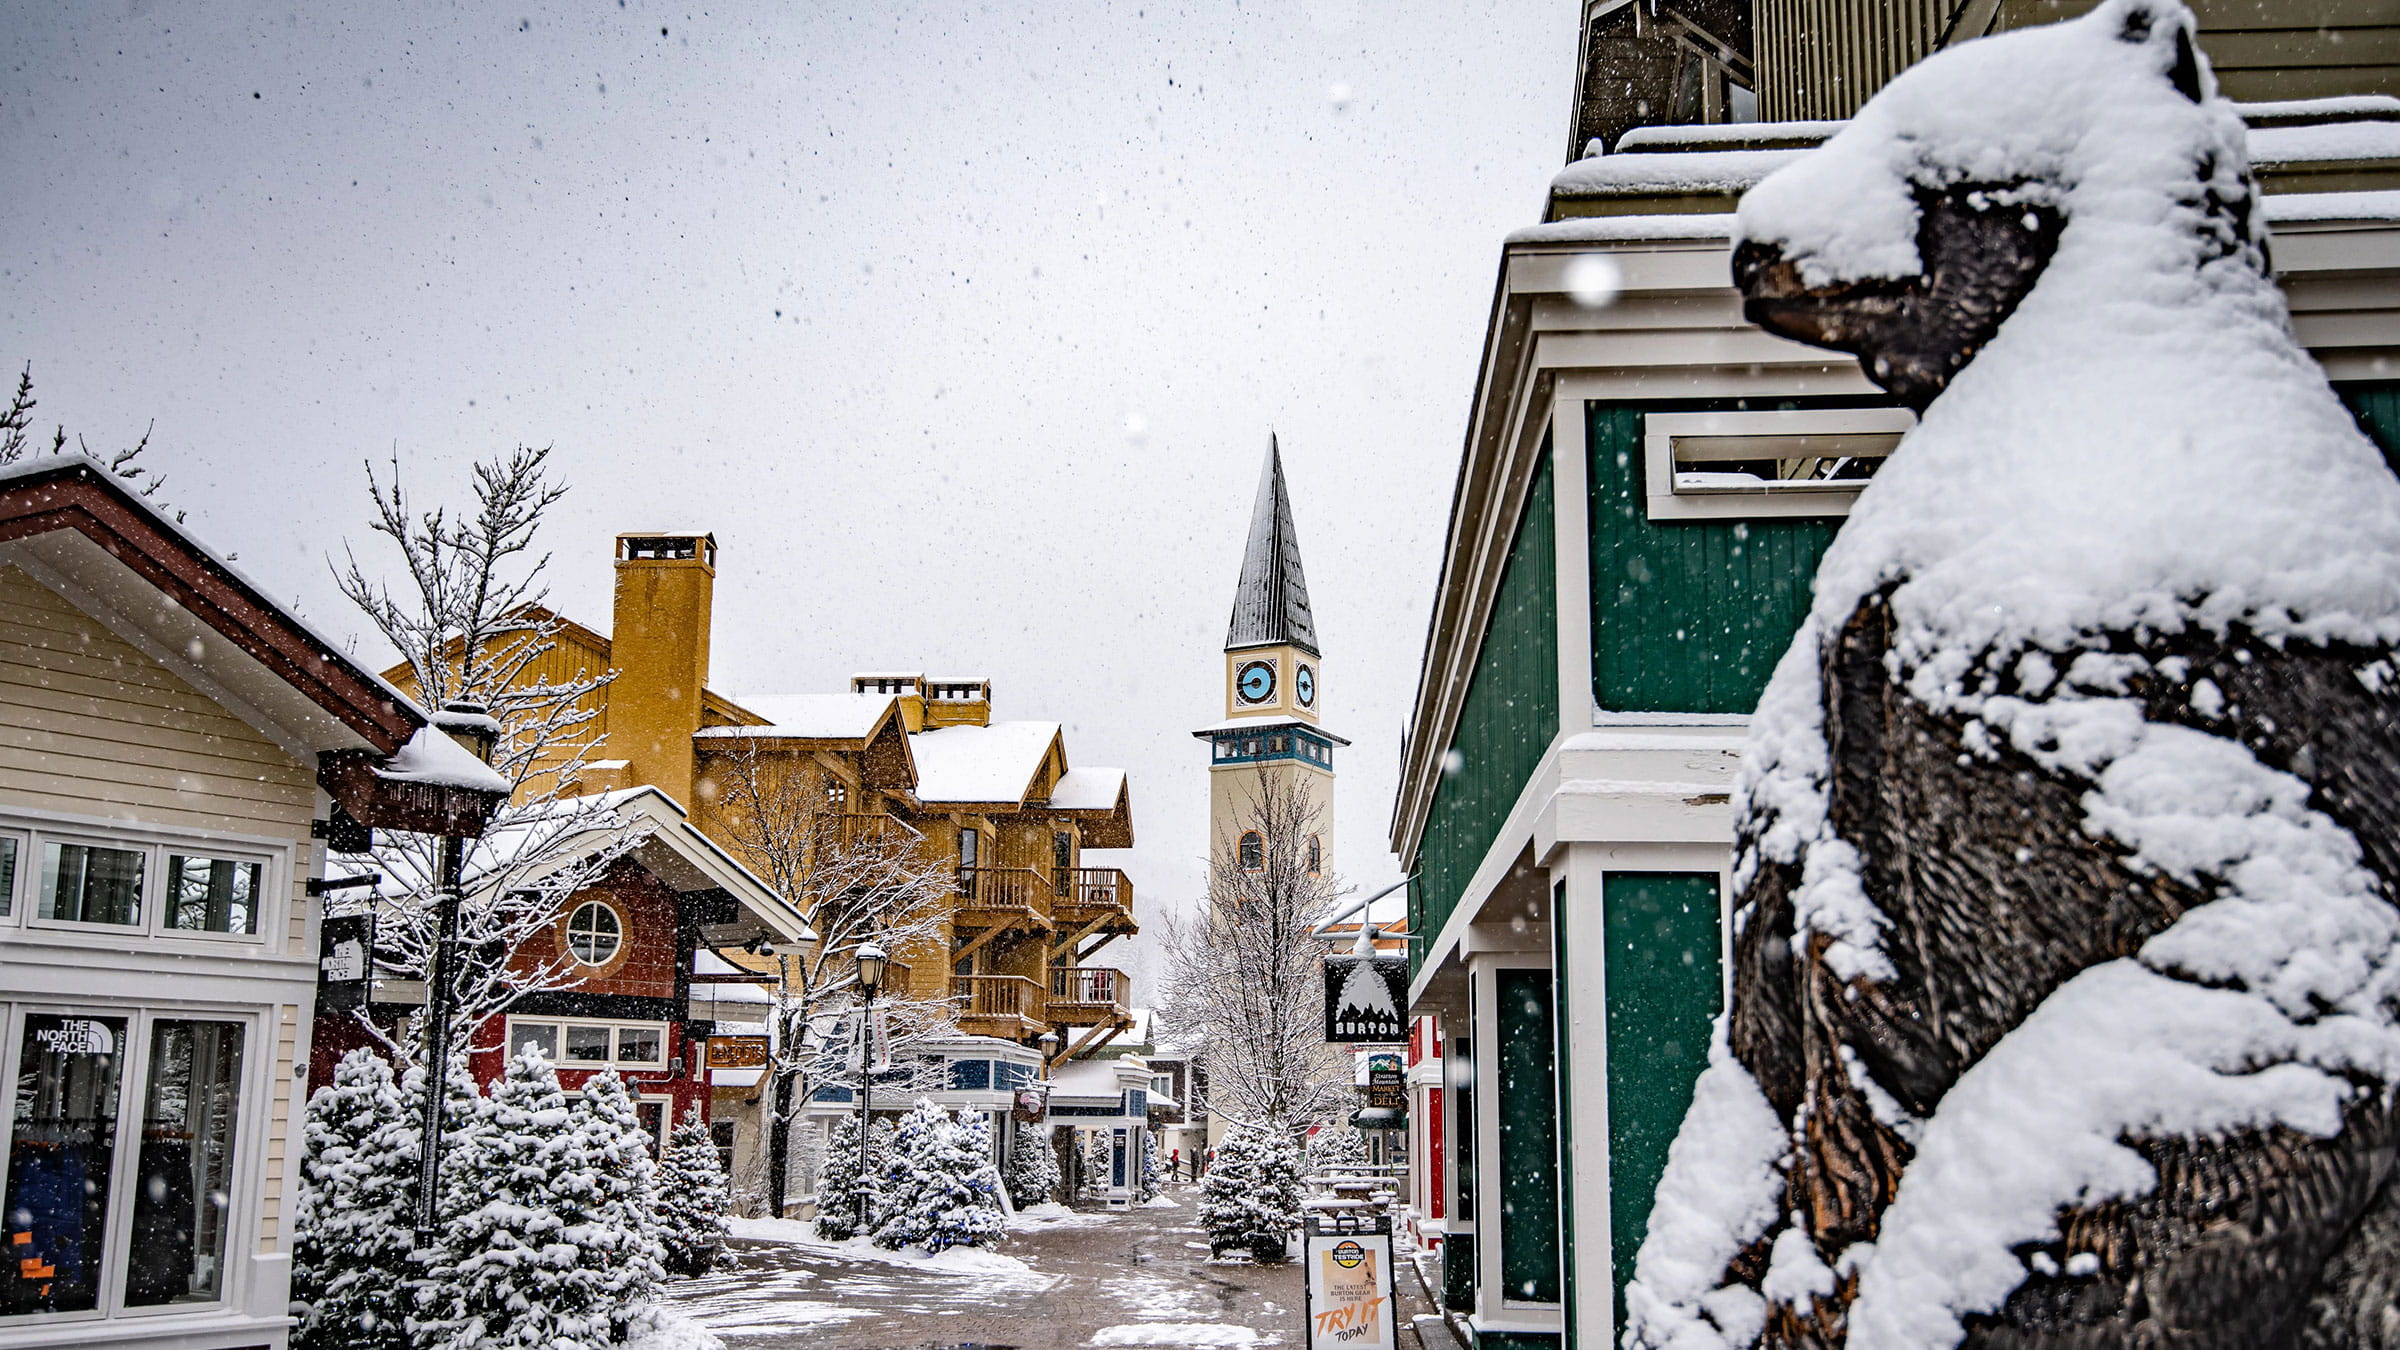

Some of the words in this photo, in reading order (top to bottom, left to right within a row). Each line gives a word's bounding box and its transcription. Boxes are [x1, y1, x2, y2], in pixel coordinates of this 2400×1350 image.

[61, 1019, 89, 1031] THE
[1335, 1021, 1399, 1036] BURTON
[36, 1029, 88, 1042] NORTH
[50, 1041, 87, 1053] FACE
[1374, 1096, 1399, 1106] DELI
[1314, 1303, 1355, 1338] TRY
[1361, 1296, 1387, 1324] IT
[1335, 1323, 1369, 1343] TODAY
